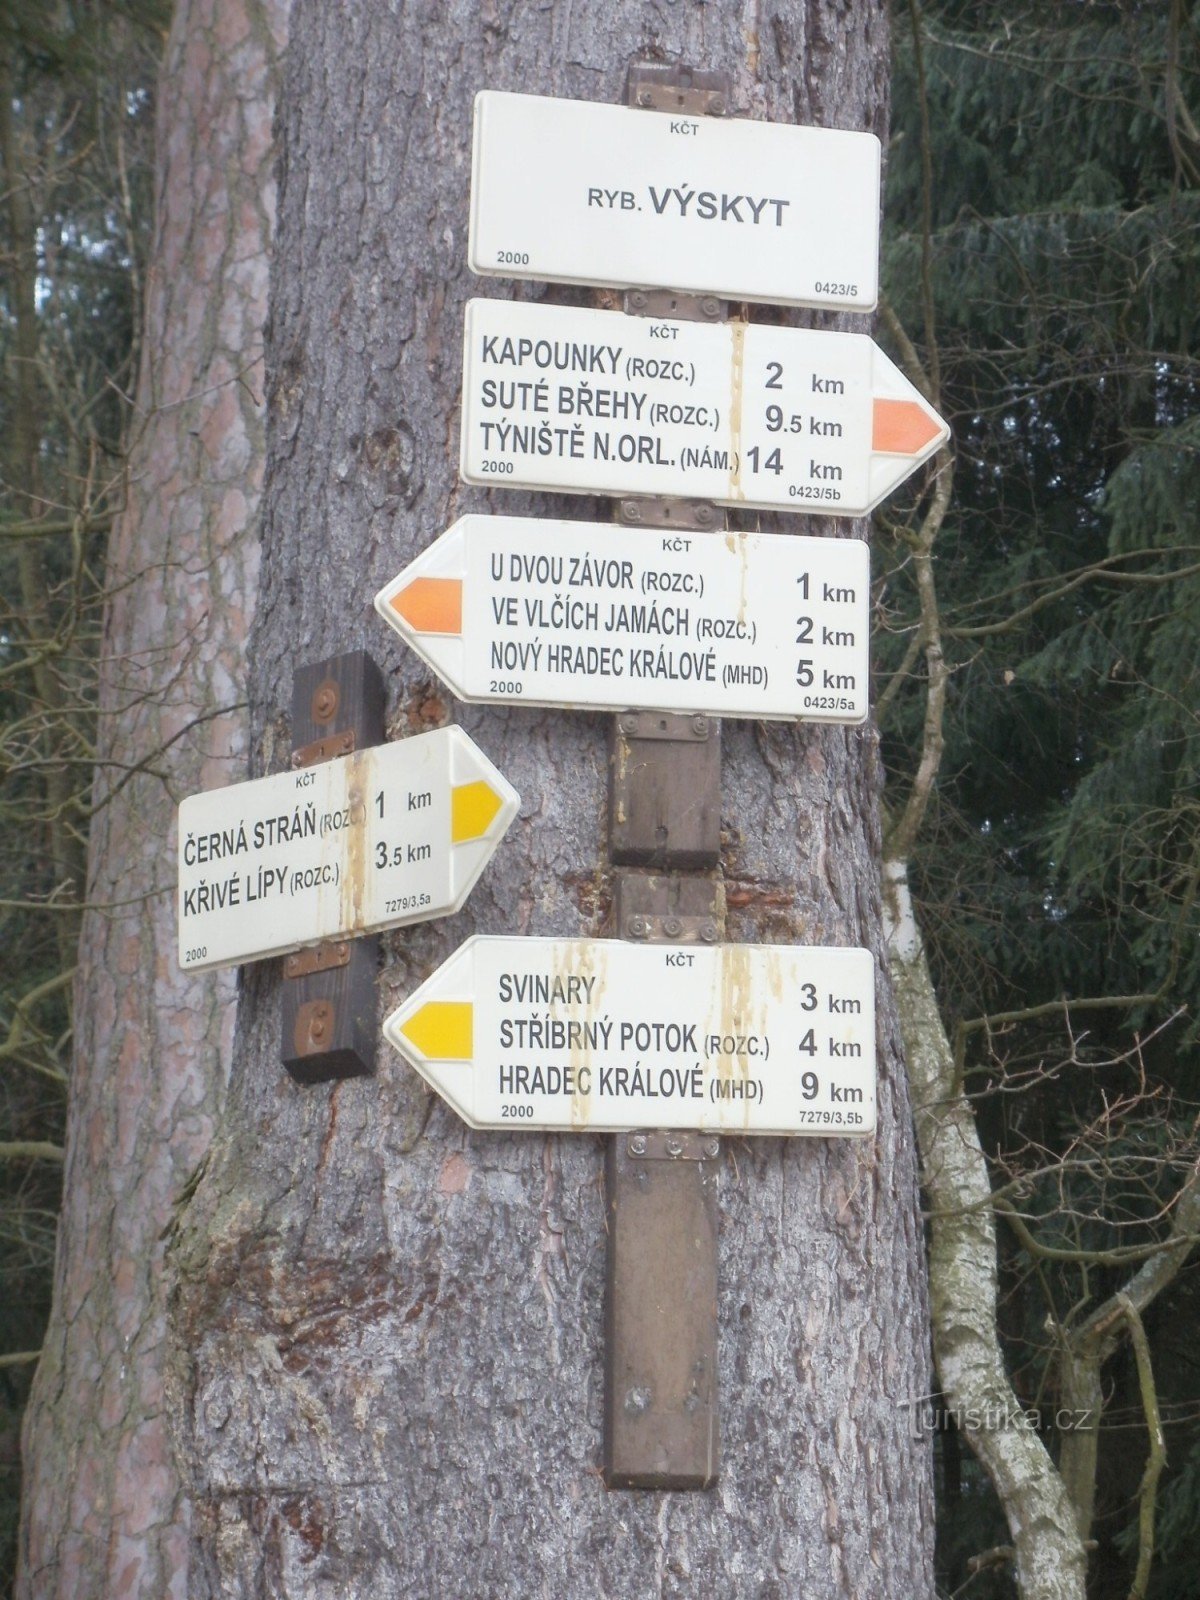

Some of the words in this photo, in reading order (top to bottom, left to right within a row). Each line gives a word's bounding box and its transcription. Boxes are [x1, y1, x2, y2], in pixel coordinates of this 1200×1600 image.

[669, 120, 699, 136] KČT
[587, 188, 642, 211] RYB.
[648, 183, 790, 226] VÝSKYT
[497, 251, 529, 265] 2000
[814, 282, 858, 296] 0423/5
[649, 325, 680, 340] KČT
[482, 336, 623, 374] KAPOUNKY
[626, 357, 696, 385] (ROZC.)
[765, 362, 783, 389] 2
[811, 374, 845, 394] km
[481, 378, 548, 412] SUTÉ
[558, 382, 647, 421] BŘEHY
[650, 402, 720, 431] (ROZC.)
[765, 405, 803, 434] 9.5
[810, 415, 843, 437] km
[480, 420, 585, 458] TÝNIŠTĚ
[593, 432, 676, 466] N.ORL.
[680, 446, 740, 473] (NÁM.)
[747, 446, 784, 475] 14
[810, 458, 843, 480] km
[481, 460, 514, 474] 2000
[788, 485, 841, 501] 0423/5b
[662, 537, 692, 552] KČT
[491, 553, 505, 582] U
[510, 554, 563, 585] DVOU
[569, 553, 634, 590] ZÁVOR
[641, 570, 704, 596] (ROZC.)
[796, 573, 810, 600] 1
[823, 582, 856, 604] km
[492, 597, 520, 626] VE
[524, 594, 598, 631] VLČÍCH
[605, 600, 689, 636] JAMÁCH
[696, 617, 757, 644] (ROZC.)
[796, 616, 814, 644] 2
[822, 627, 855, 647] km
[491, 638, 543, 672] NOVÝ
[547, 645, 624, 677] HRADEC
[629, 644, 716, 682] KRÁLOVÉ
[722, 664, 768, 690] (MHD)
[796, 659, 814, 688] 5
[823, 670, 856, 691] km
[489, 681, 523, 695] 2000
[803, 695, 855, 711] 0423/5a
[295, 771, 317, 788] KČT
[183, 820, 248, 866] ČERNÁ
[253, 802, 316, 849] STRÁŇ
[375, 790, 385, 819] 1
[408, 790, 432, 811] km
[183, 872, 241, 916] KŘIVÉ
[246, 864, 288, 902] LÍPY
[290, 862, 340, 895] (ROZC.)
[375, 841, 402, 870] 3.5
[407, 841, 432, 862] km
[385, 893, 431, 914] 7279/3,5a
[185, 946, 208, 962] 2000
[665, 952, 695, 967] KČT
[499, 973, 596, 1005] SVINARY
[800, 983, 818, 1011] 3
[829, 992, 861, 1014] km
[500, 1012, 614, 1050] STŘÍBRNÝ
[620, 1023, 698, 1053] POTOK
[704, 1035, 770, 1061] (ROZC.)
[798, 1029, 817, 1057] 4
[829, 1036, 862, 1057] km
[500, 1065, 592, 1095] HRADEC
[599, 1061, 704, 1098] KRÁLOVÉ
[710, 1078, 764, 1104] (MHD)
[801, 1072, 819, 1100] 9
[830, 1081, 863, 1103] km
[501, 1104, 534, 1118] 2000
[799, 1109, 863, 1126] 7279/3,5b
